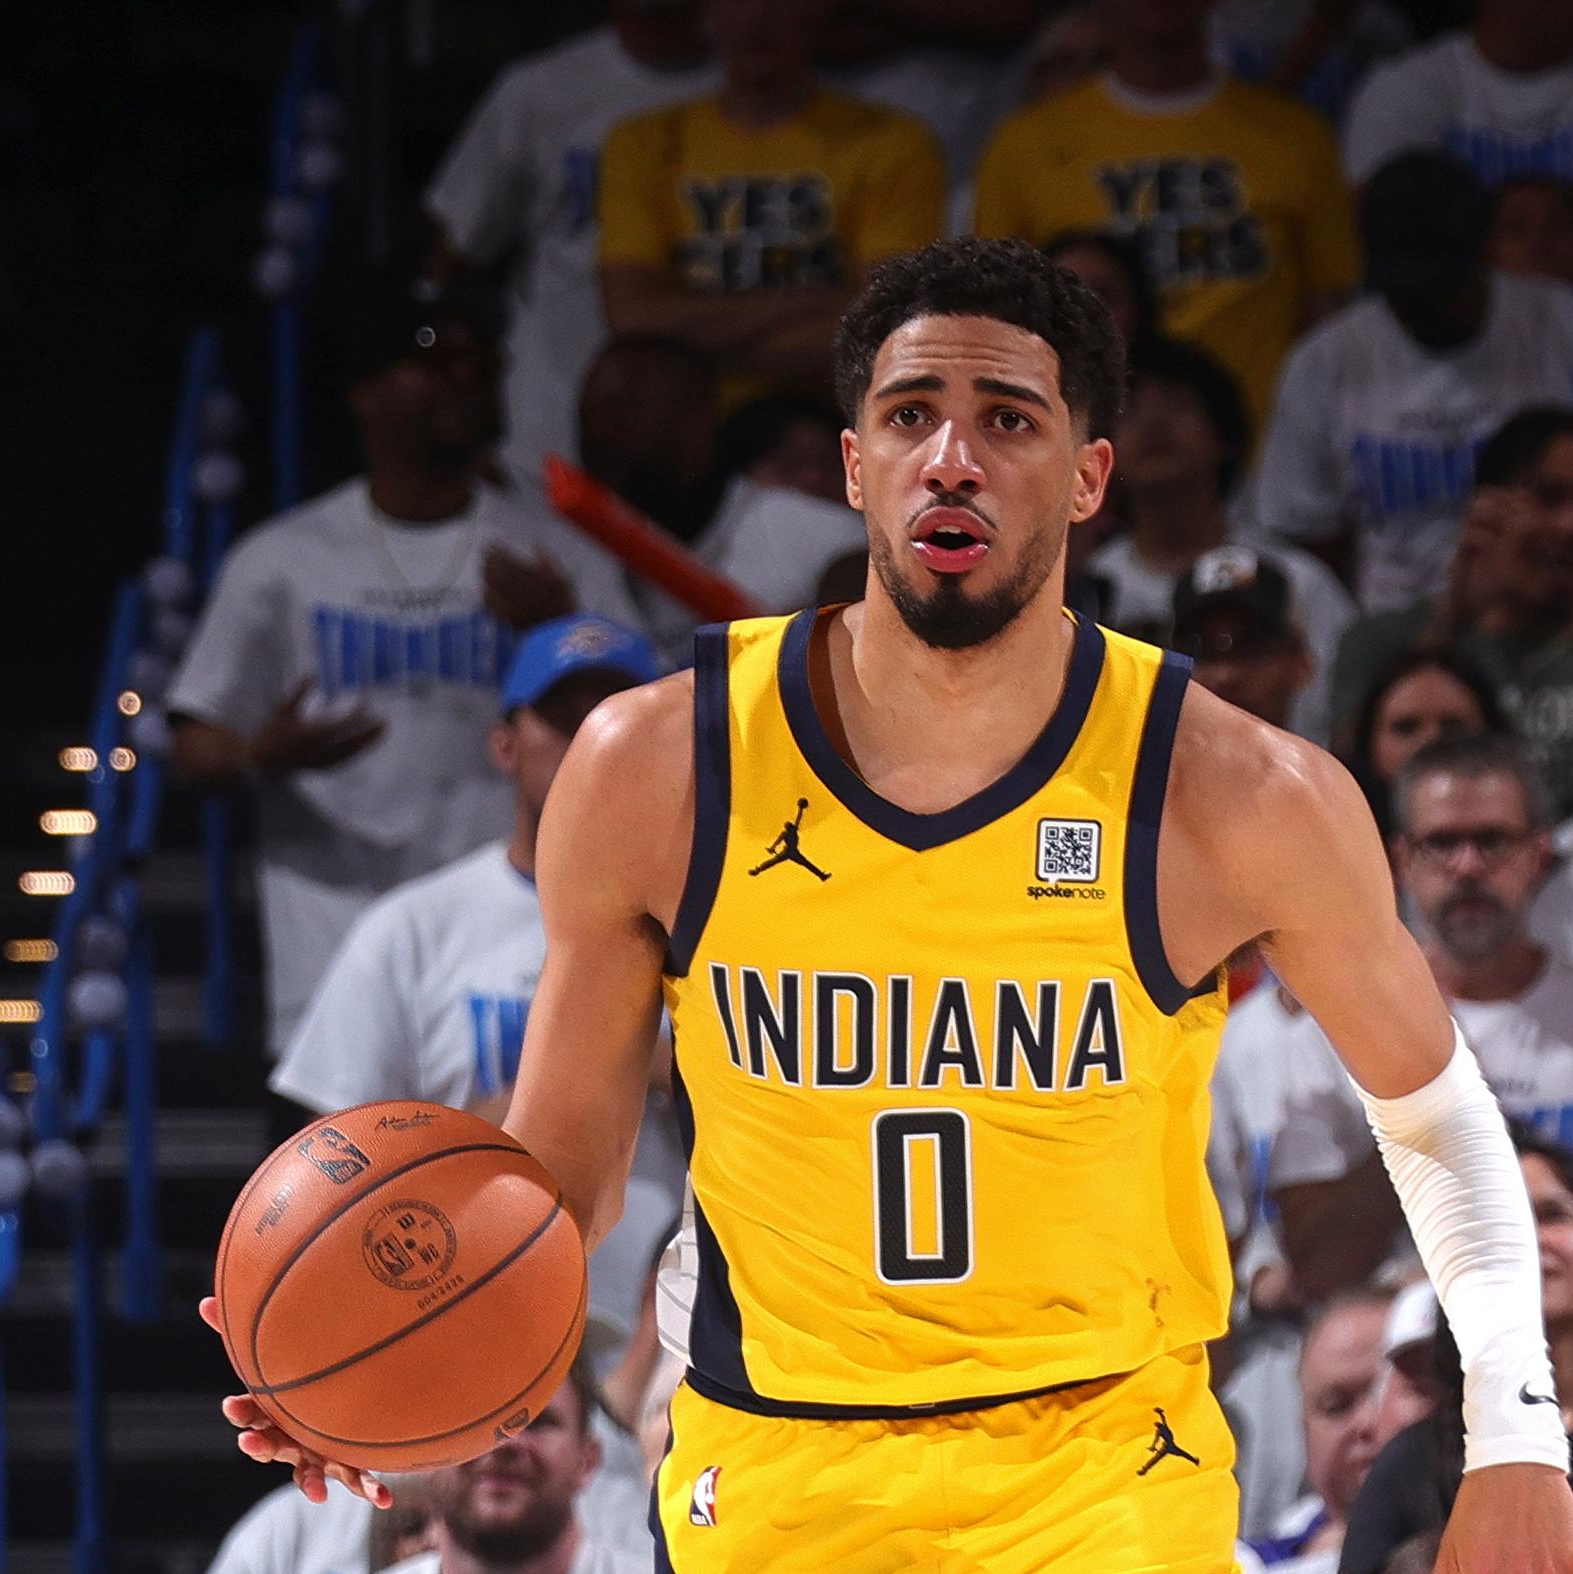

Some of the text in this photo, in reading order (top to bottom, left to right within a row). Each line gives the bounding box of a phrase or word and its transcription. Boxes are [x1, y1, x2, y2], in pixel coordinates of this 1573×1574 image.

[1026, 883, 1106, 900] spokenote
[708, 961, 1127, 1092] INDIANA
[870, 1106, 975, 1286] 0
